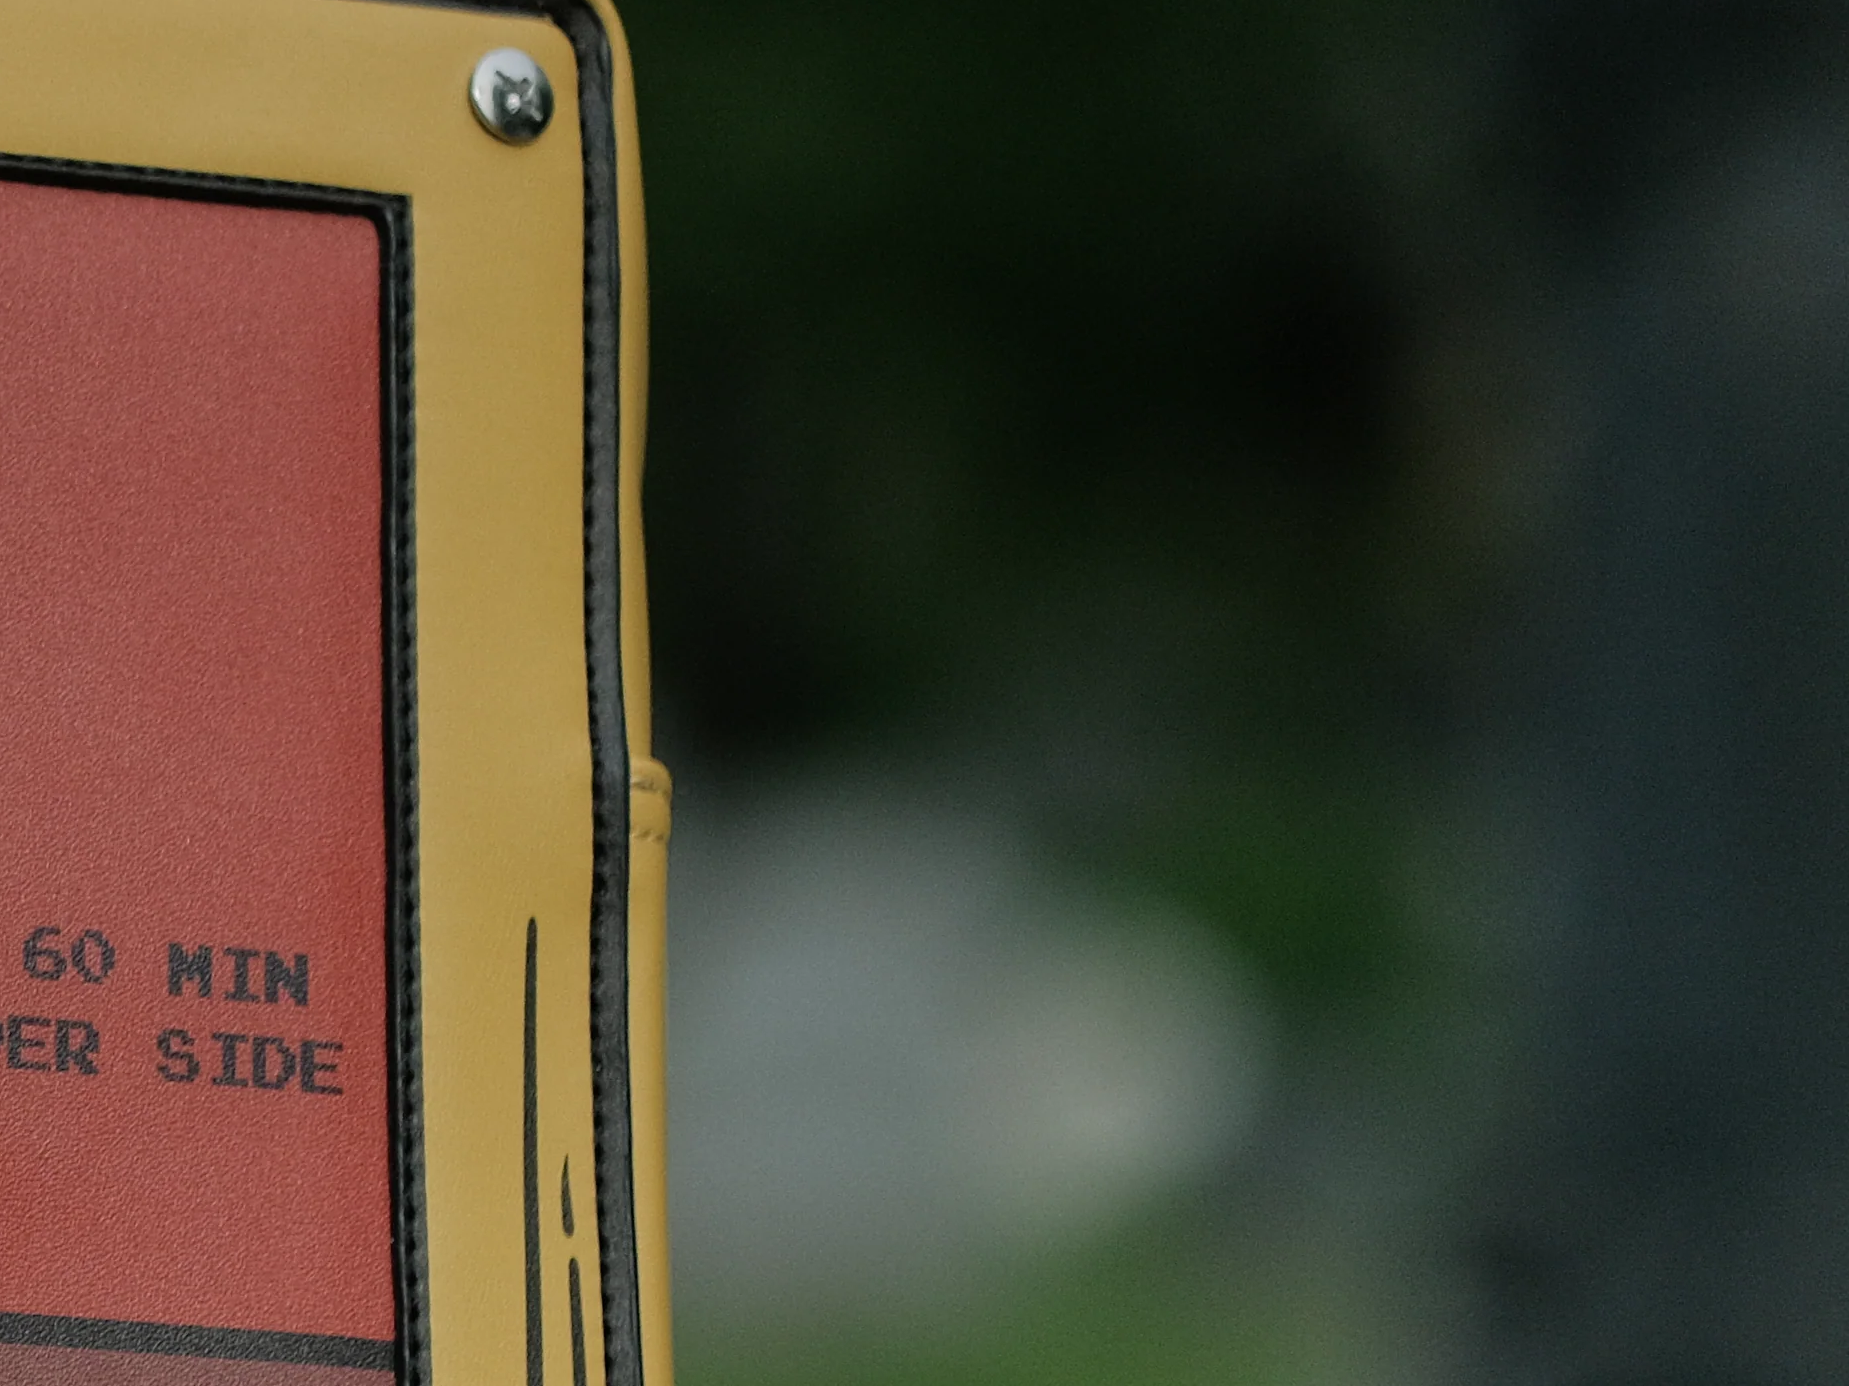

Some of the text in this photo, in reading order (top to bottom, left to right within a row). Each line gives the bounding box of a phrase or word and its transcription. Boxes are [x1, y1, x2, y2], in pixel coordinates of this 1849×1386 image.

[22, 926, 309, 1006] 60 MIN
[156, 1027, 346, 1096] SIDE
